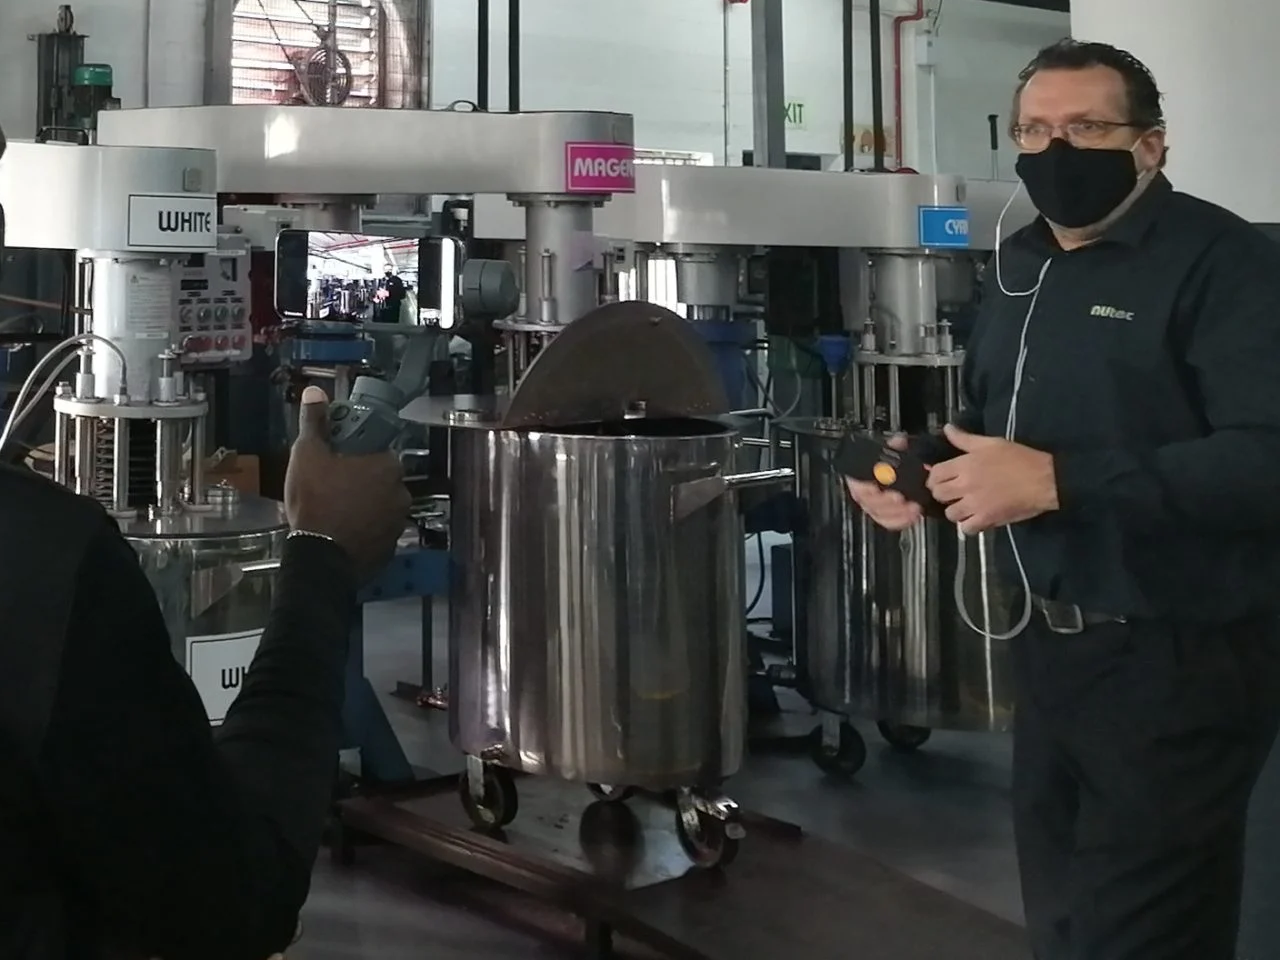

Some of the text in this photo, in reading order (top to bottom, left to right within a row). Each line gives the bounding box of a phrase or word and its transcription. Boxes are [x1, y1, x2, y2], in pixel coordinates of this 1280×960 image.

[784, 102, 804, 124] XIT
[158, 210, 211, 232] WHITE
[945, 218, 968, 235] CYA
